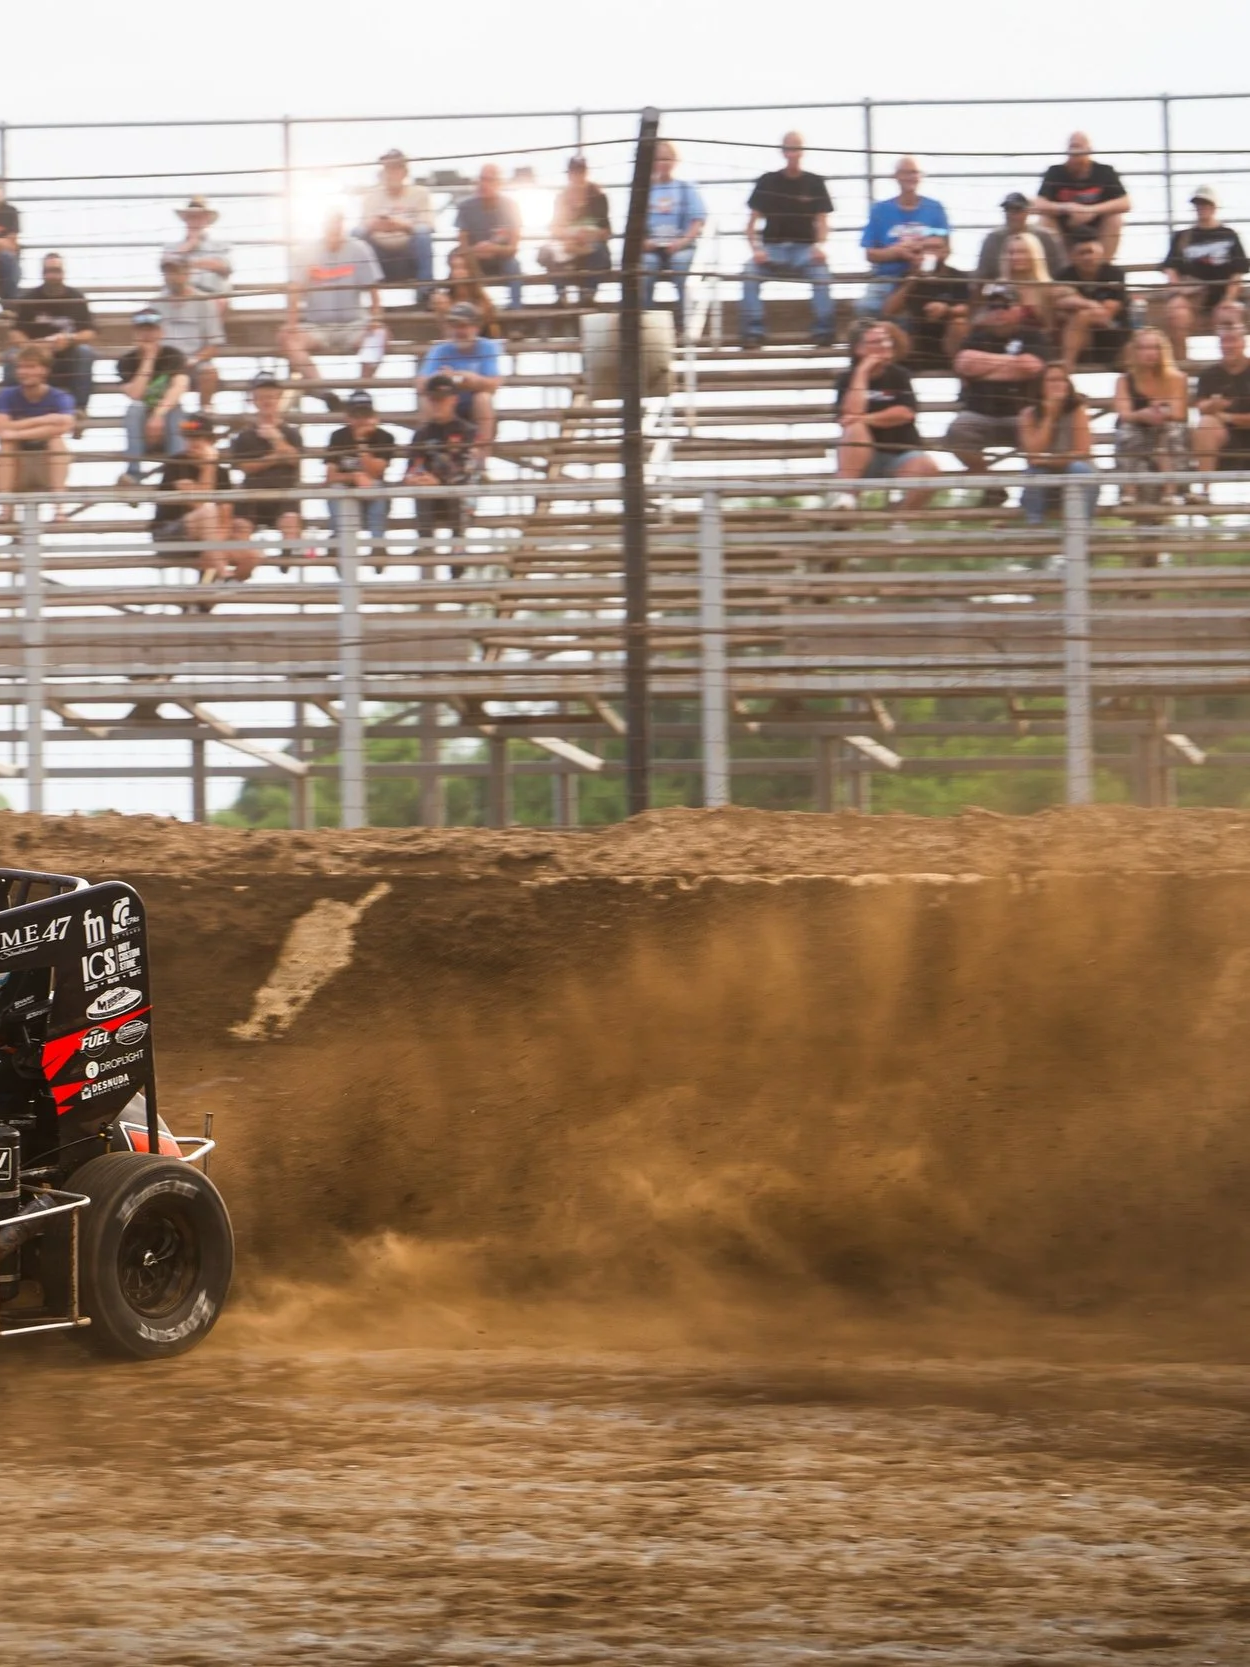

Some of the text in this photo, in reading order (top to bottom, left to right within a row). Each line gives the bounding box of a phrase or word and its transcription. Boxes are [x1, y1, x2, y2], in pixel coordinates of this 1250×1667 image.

[41, 915, 72, 942] 47
[82, 948, 116, 983] ICS
[80, 1031, 110, 1051] FUEL
[91, 1073, 129, 1093] DESNUDA
